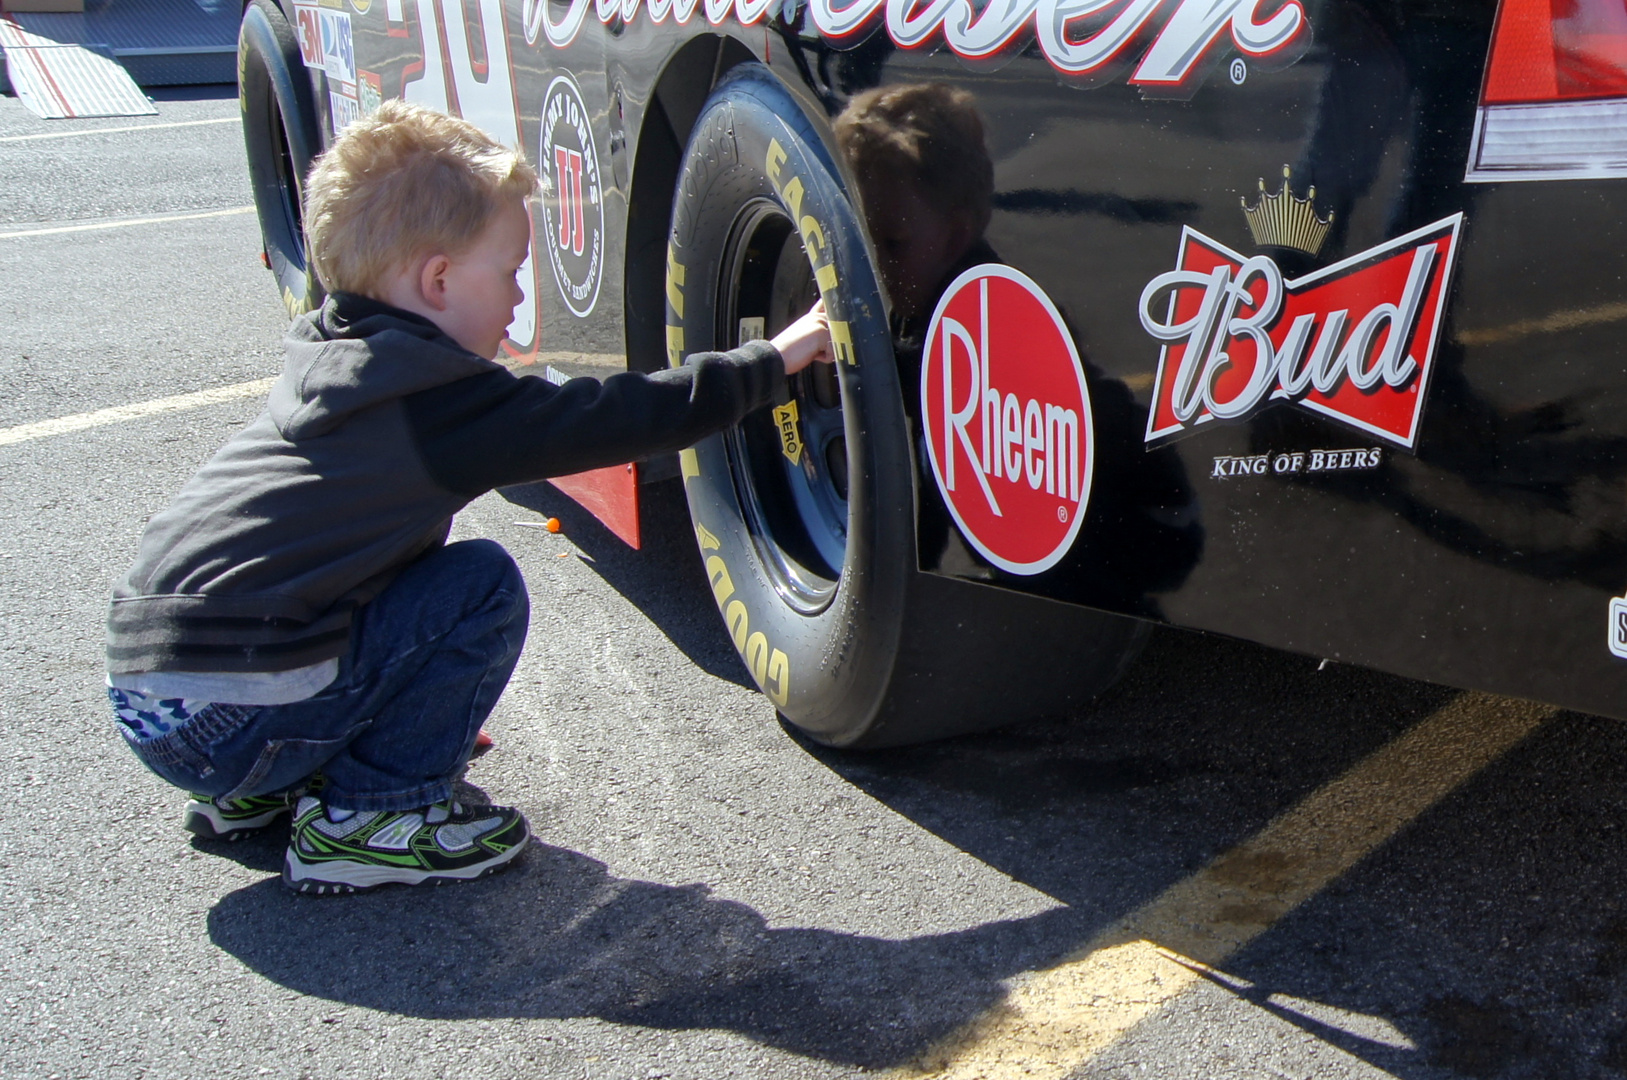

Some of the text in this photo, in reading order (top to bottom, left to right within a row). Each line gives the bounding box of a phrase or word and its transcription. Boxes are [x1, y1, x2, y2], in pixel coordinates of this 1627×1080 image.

[298, 9, 325, 66] 3M
[542, 92, 563, 190] JIMMY
[565, 93, 598, 205] JOHN'S
[546, 207, 600, 301] GOURMET SANDWICHES
[765, 136, 856, 366] EAGLE
[1139, 242, 1438, 421] Bud
[780, 411, 797, 454] AERO
[941, 278, 1079, 518] Rheem
[1212, 450, 1381, 477] KING OF BEERS
